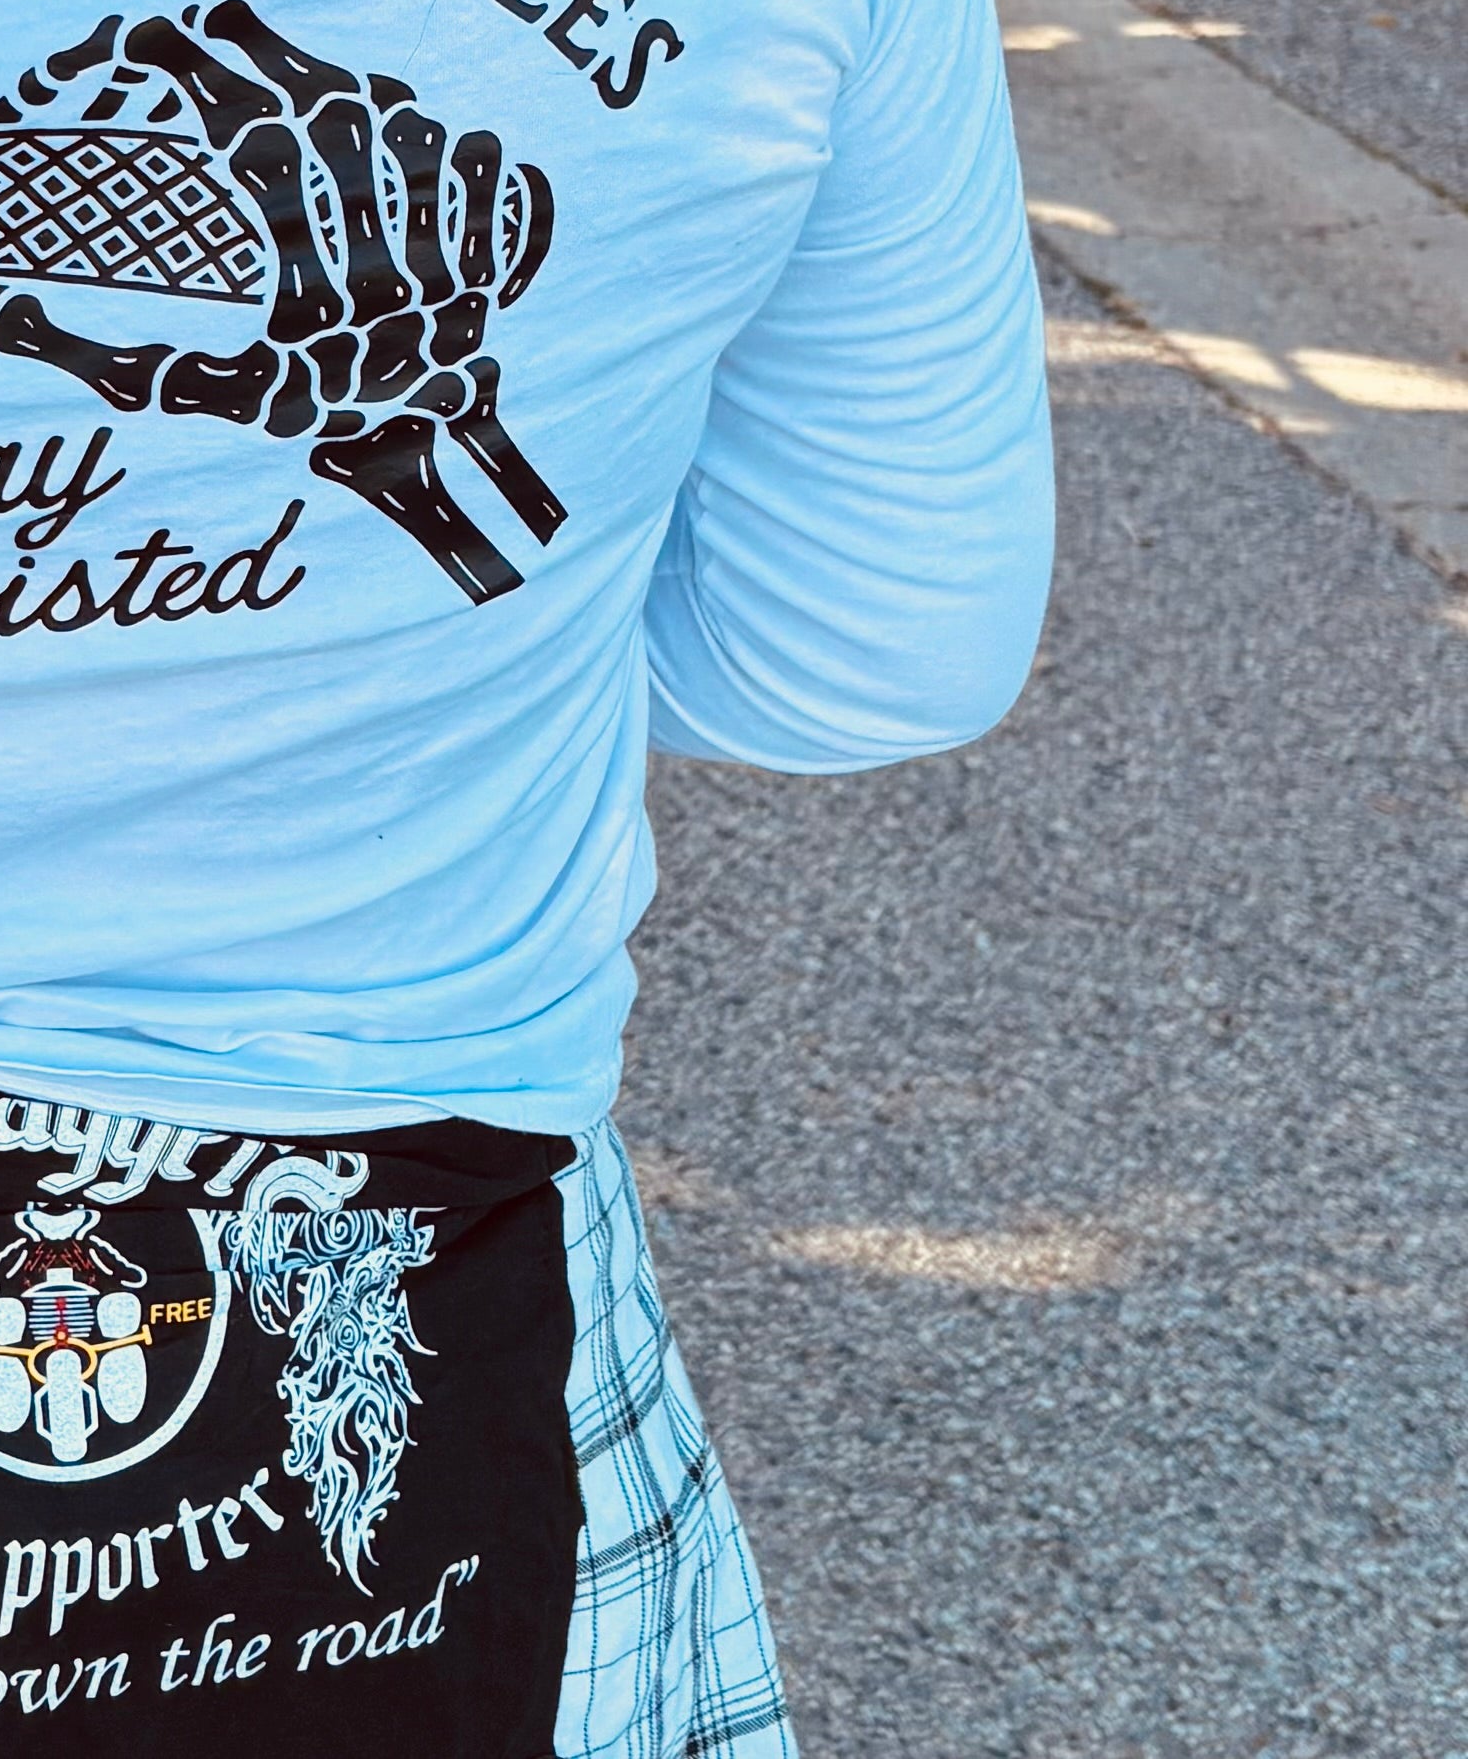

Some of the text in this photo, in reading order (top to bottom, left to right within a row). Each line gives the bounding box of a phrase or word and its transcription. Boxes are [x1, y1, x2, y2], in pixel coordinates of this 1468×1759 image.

[150, 1296, 214, 1325] FREE
[159, 1613, 272, 1692] the
[296, 1554, 480, 1672] road”
